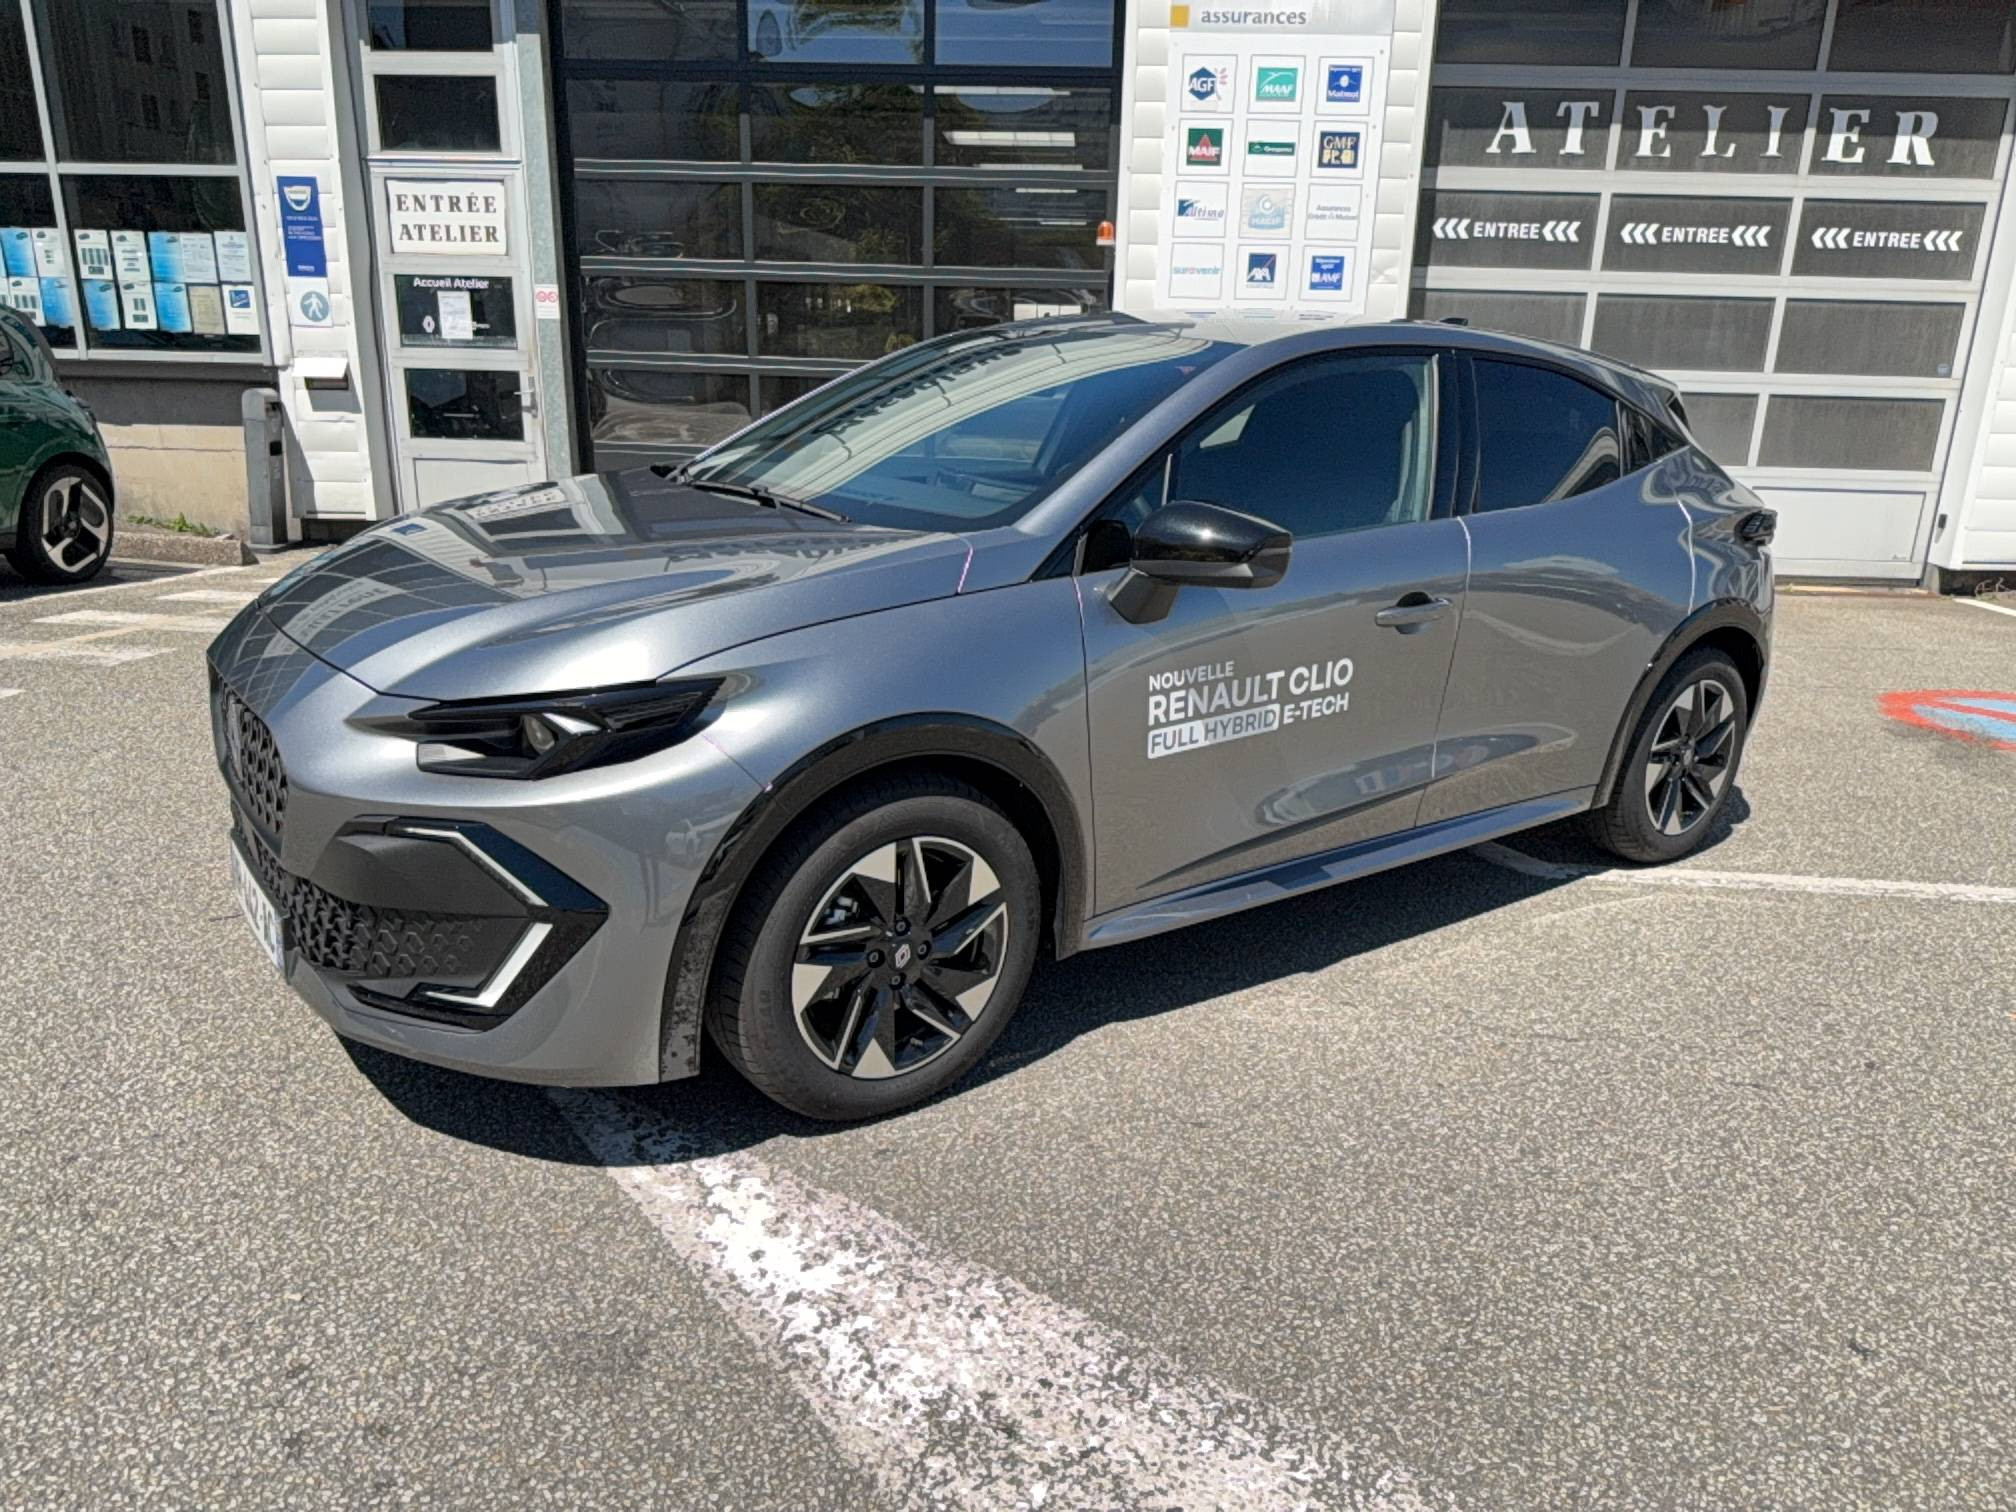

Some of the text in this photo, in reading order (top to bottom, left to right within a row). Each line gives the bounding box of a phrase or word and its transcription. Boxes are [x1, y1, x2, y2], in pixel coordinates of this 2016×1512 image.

[1201, 10, 1307, 25] assurances
[1188, 77, 1217, 92] AGF
[1323, 135, 1356, 150] GMF
[1485, 101, 1939, 167] ATELIER
[395, 192, 497, 214] ENTRÉE
[398, 223, 500, 243] ATELIER
[1473, 220, 1540, 241] ENTREE
[1661, 225, 1730, 245] ENTREE
[1853, 230, 1921, 251] ENTREE
[413, 277, 490, 289] Accueil Atelier
[1149, 660, 1235, 692] NOUVELLE
[1148, 657, 1354, 727] RENAULT CLIO
[1150, 692, 1350, 755] FULL HYBRID E-TECH
